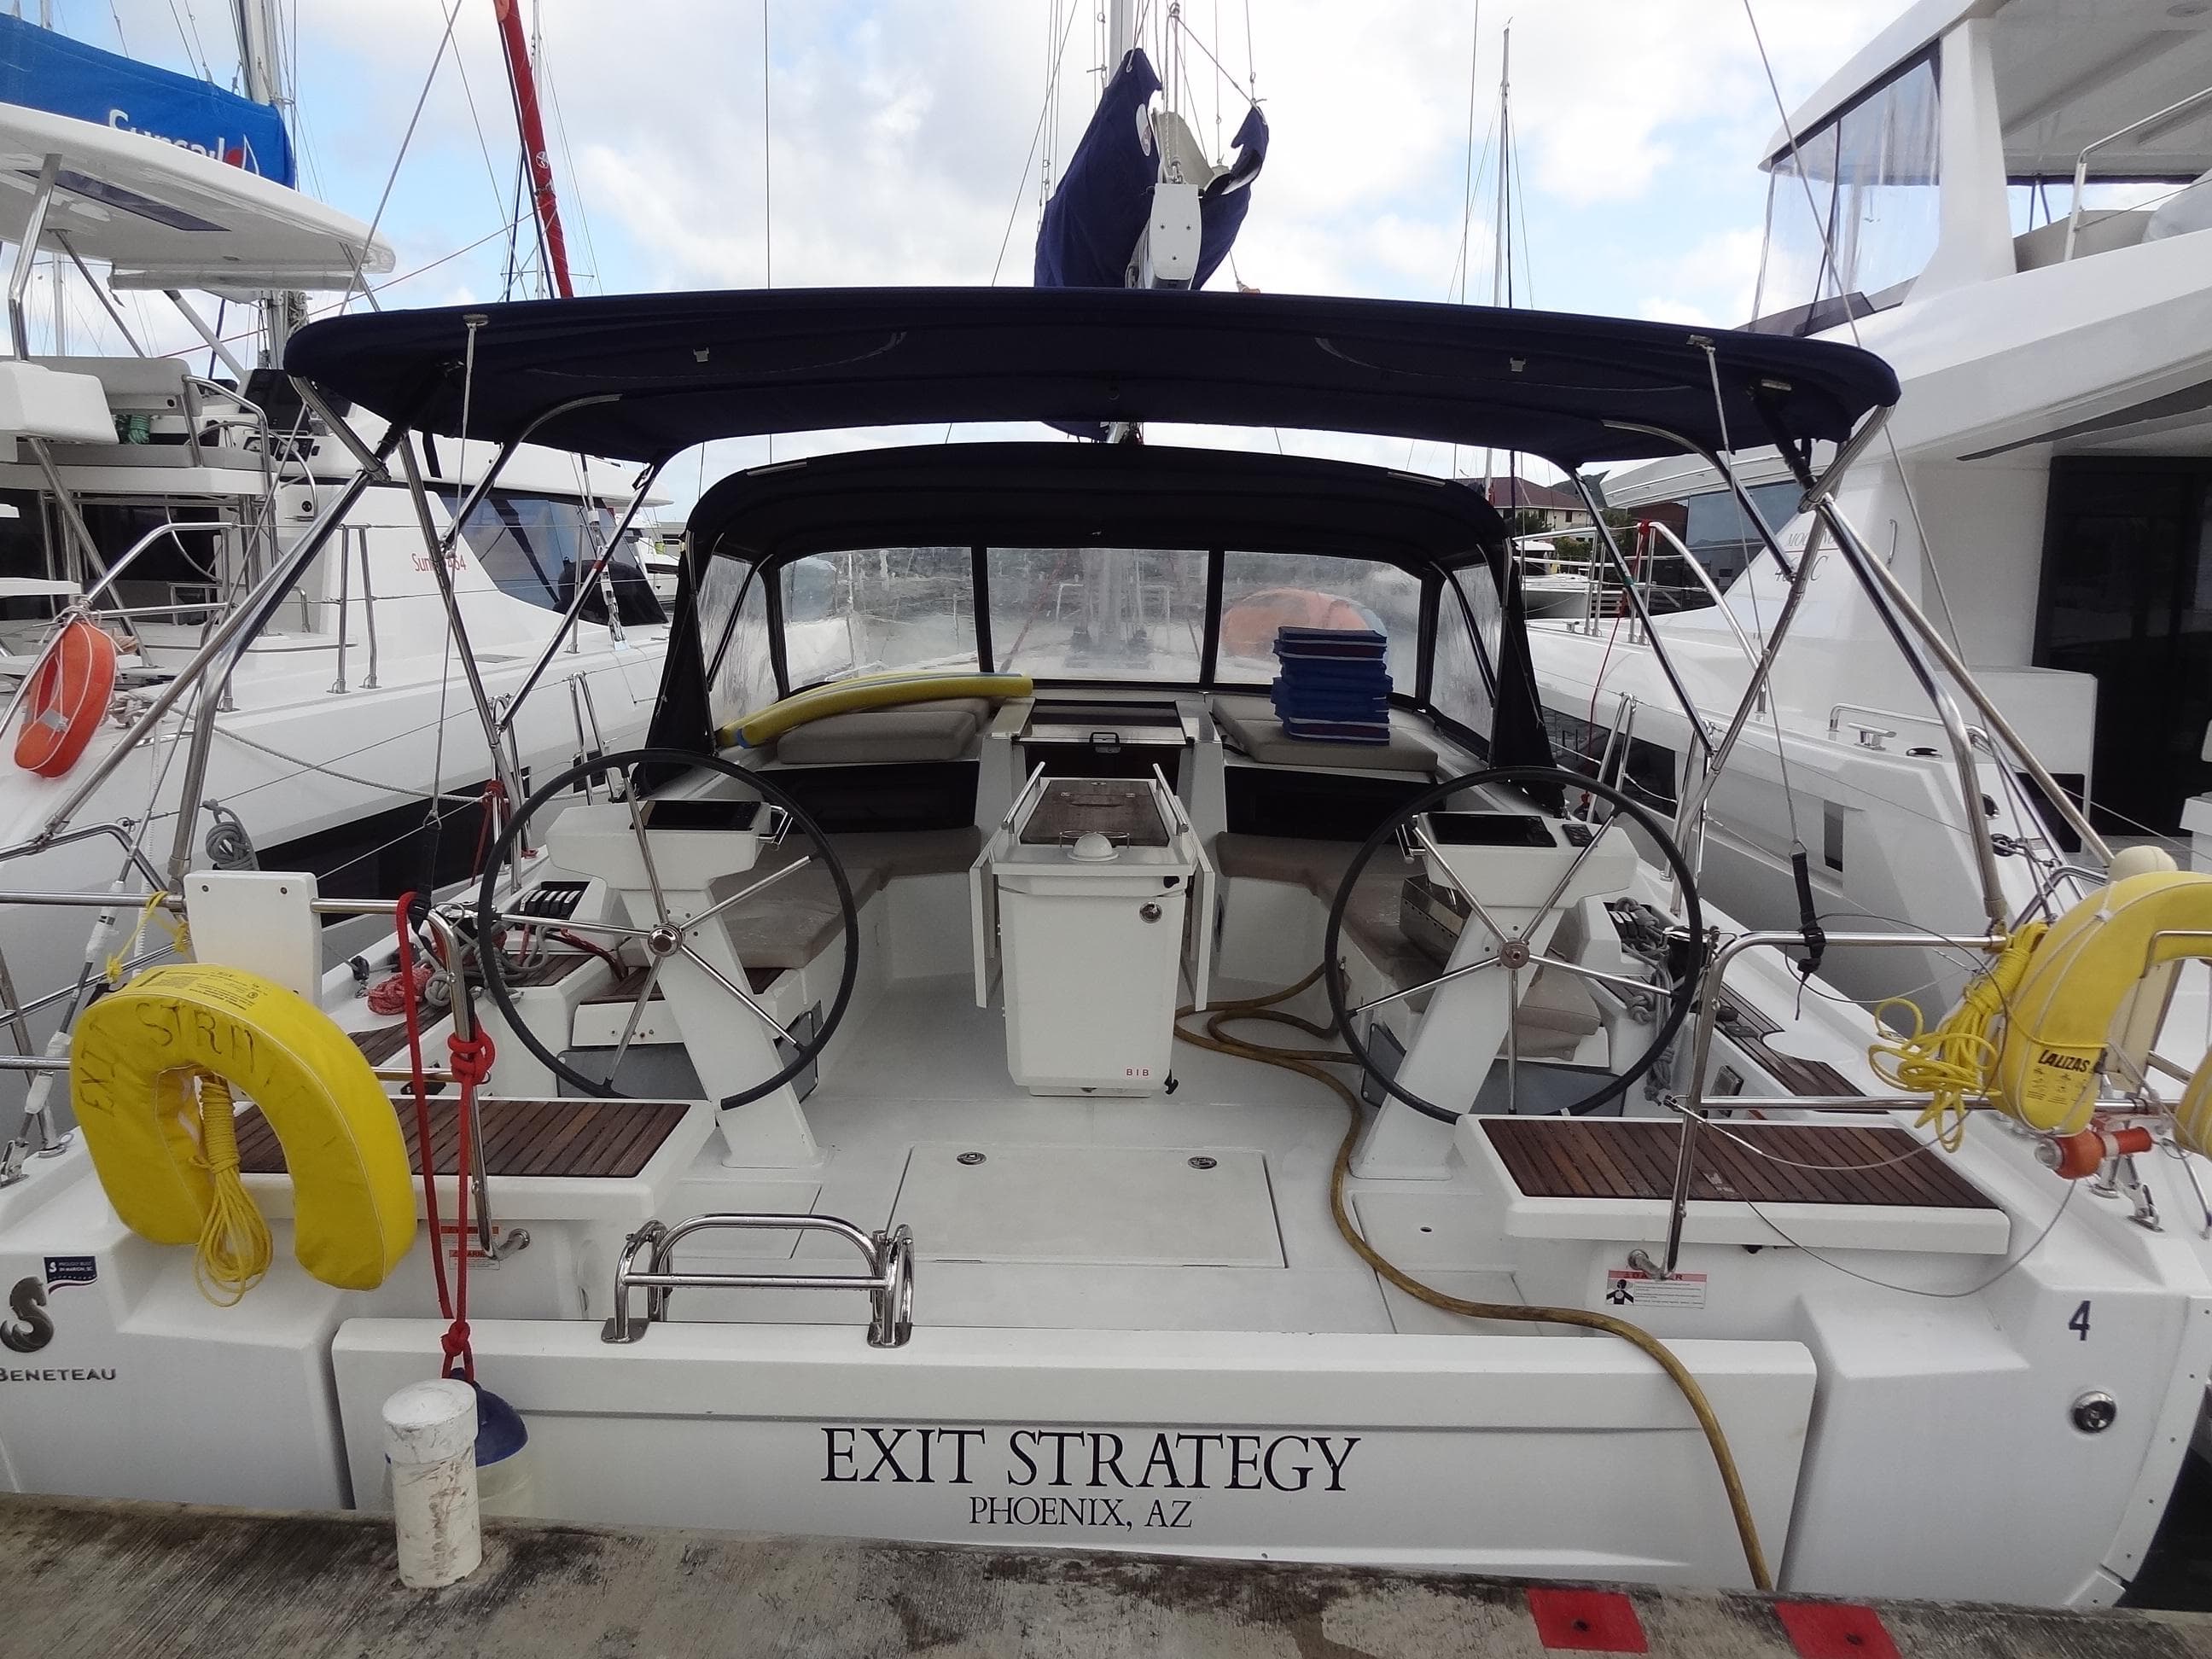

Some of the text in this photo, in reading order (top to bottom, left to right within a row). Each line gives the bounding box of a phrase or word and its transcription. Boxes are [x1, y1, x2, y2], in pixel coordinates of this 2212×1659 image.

[2038, 1050, 2090, 1073] LALIZAS
[2069, 1301, 2091, 1341] 4
[821, 1428, 1361, 1492] EXIT STRATEGY
[969, 1497, 1192, 1533] PHOENIX, AZ
